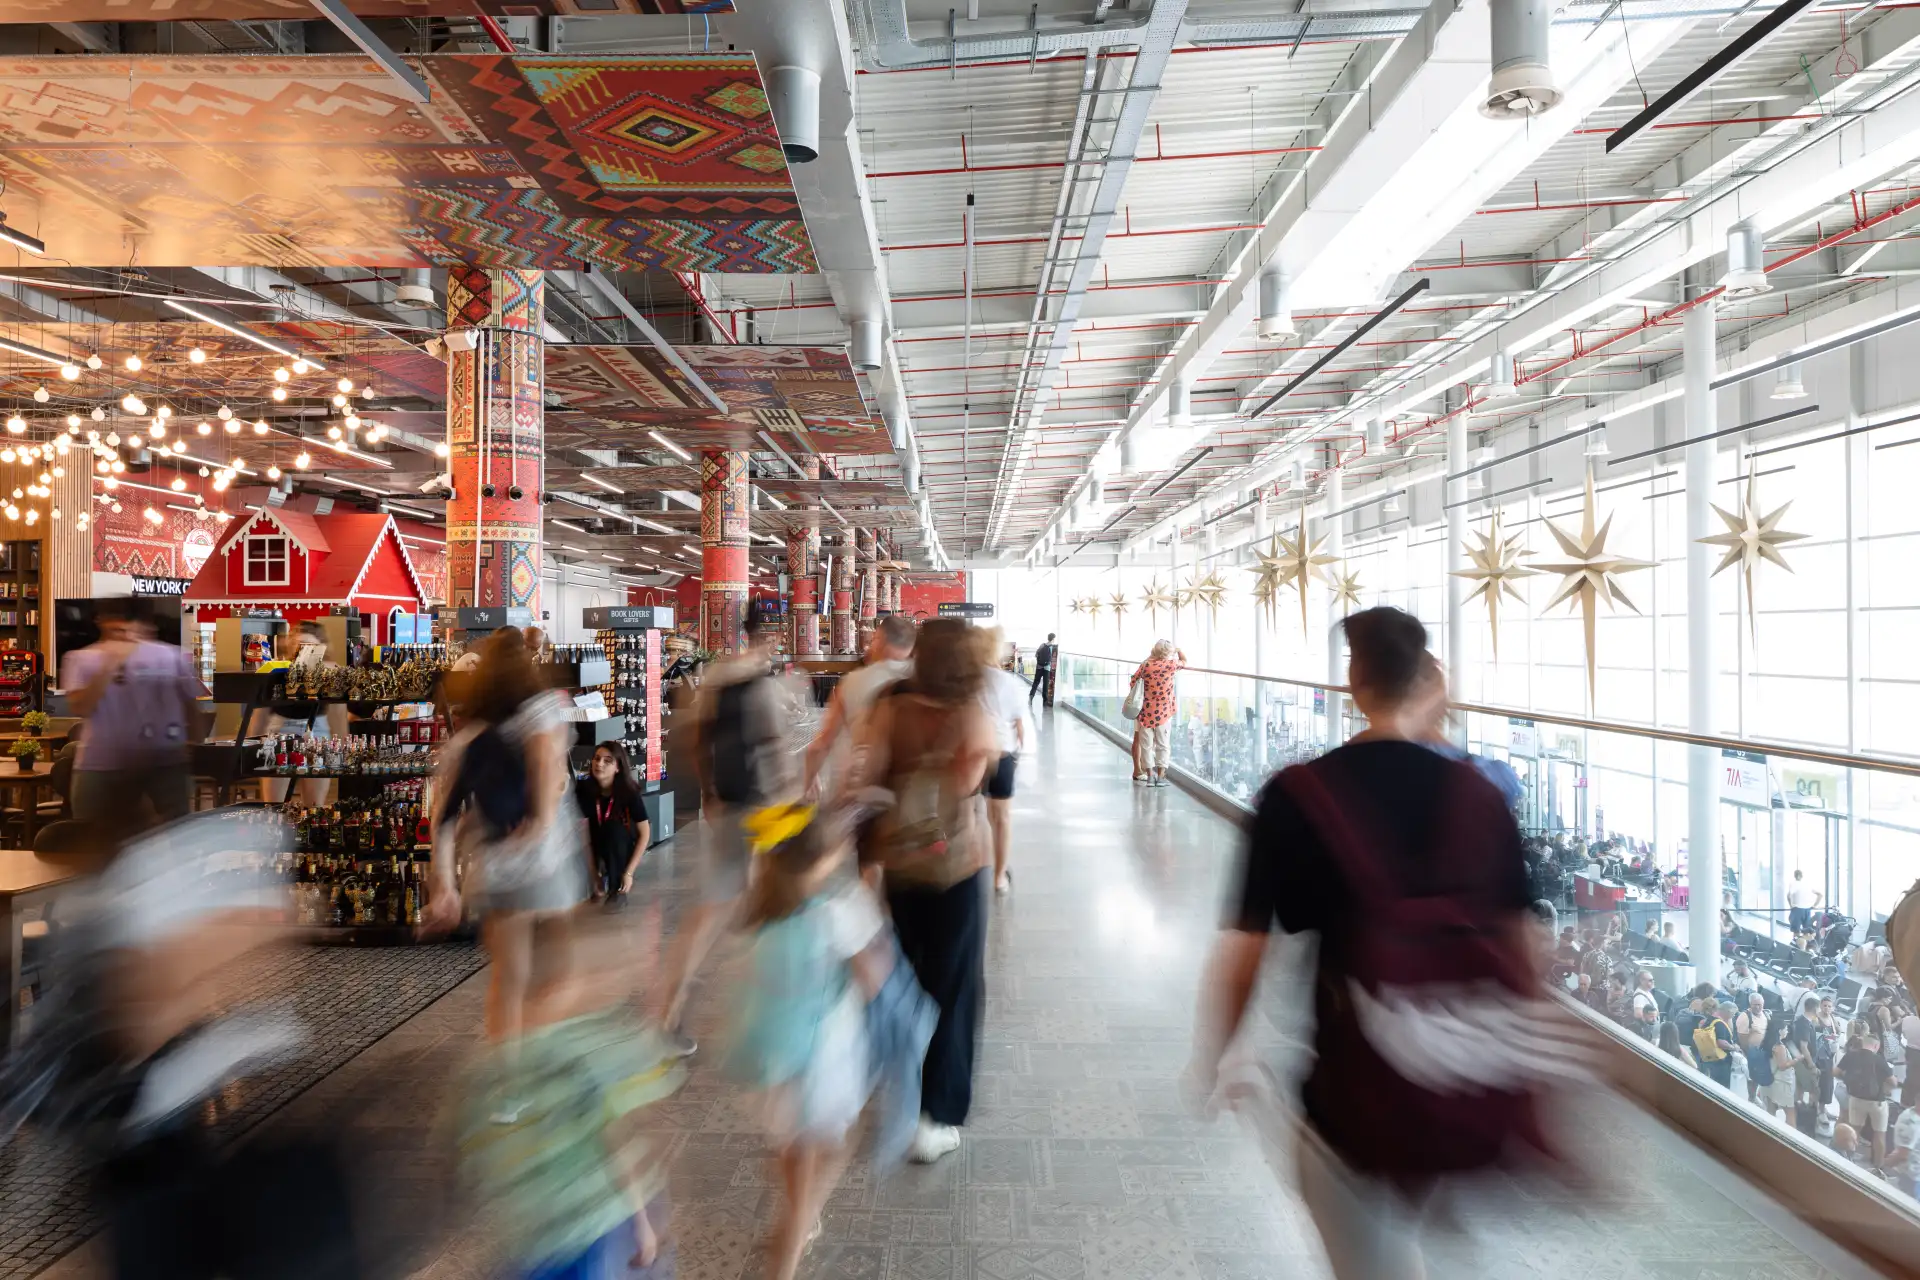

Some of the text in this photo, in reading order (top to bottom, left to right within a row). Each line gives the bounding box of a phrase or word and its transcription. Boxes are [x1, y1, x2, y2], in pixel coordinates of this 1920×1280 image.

[132, 578, 155, 593] NEW
[156, 580, 182, 594] YORK
[611, 610, 627, 618] BOOK
